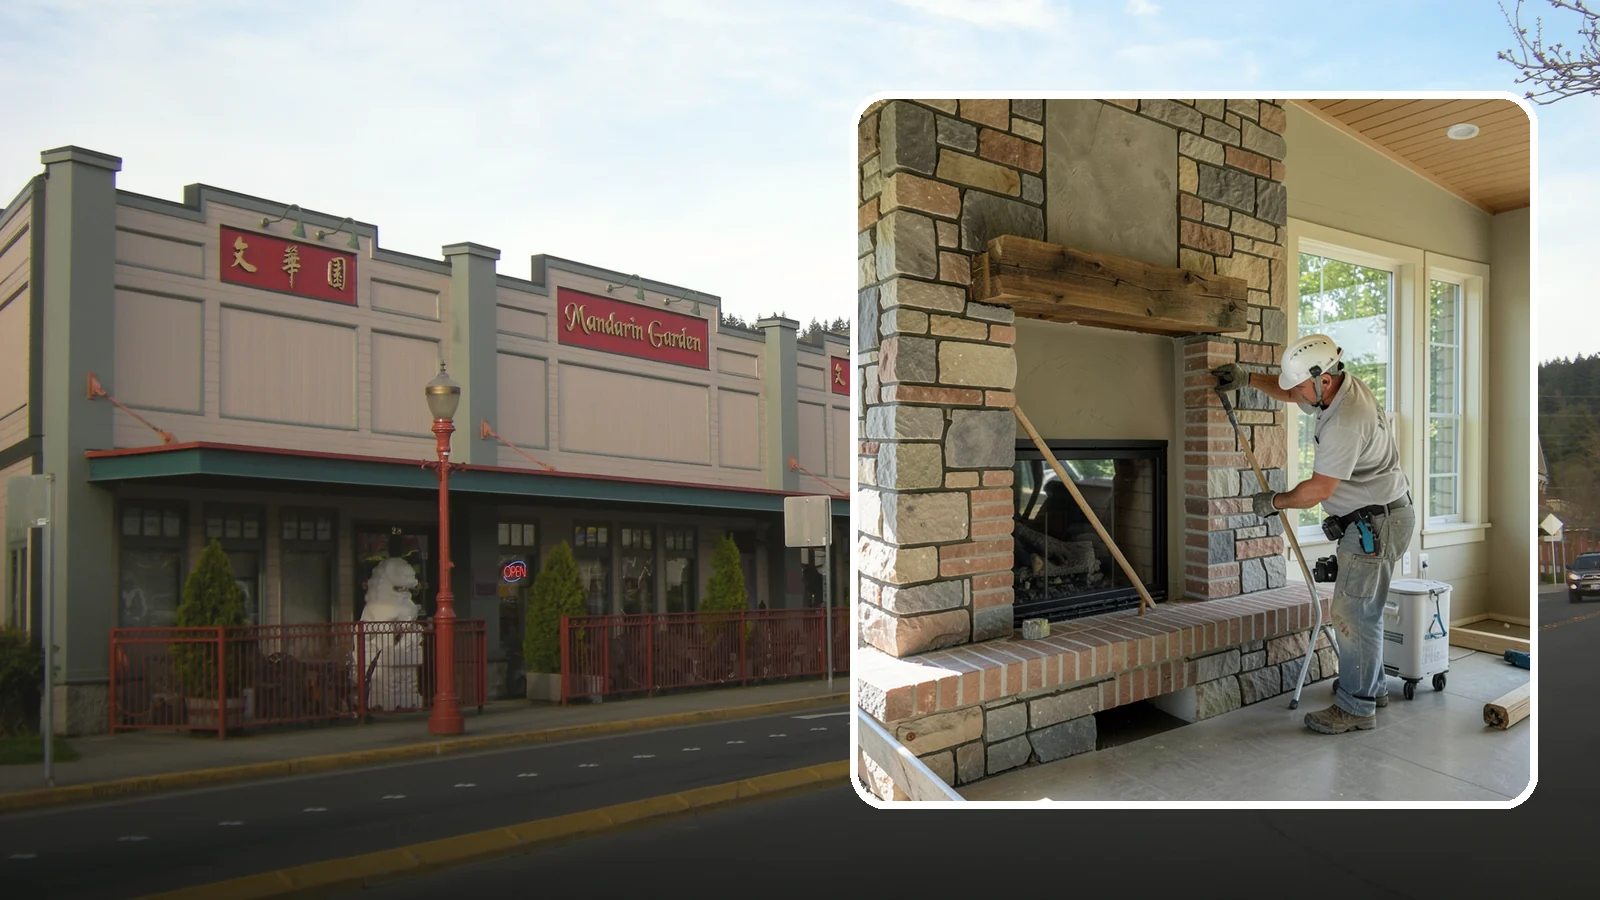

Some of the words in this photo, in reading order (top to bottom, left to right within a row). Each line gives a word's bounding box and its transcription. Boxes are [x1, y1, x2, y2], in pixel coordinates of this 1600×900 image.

[231, 236, 346, 290] 文華園
[565, 303, 643, 340] Mandarin
[648, 320, 701, 351] Garden
[503, 565, 527, 578] OPEN
